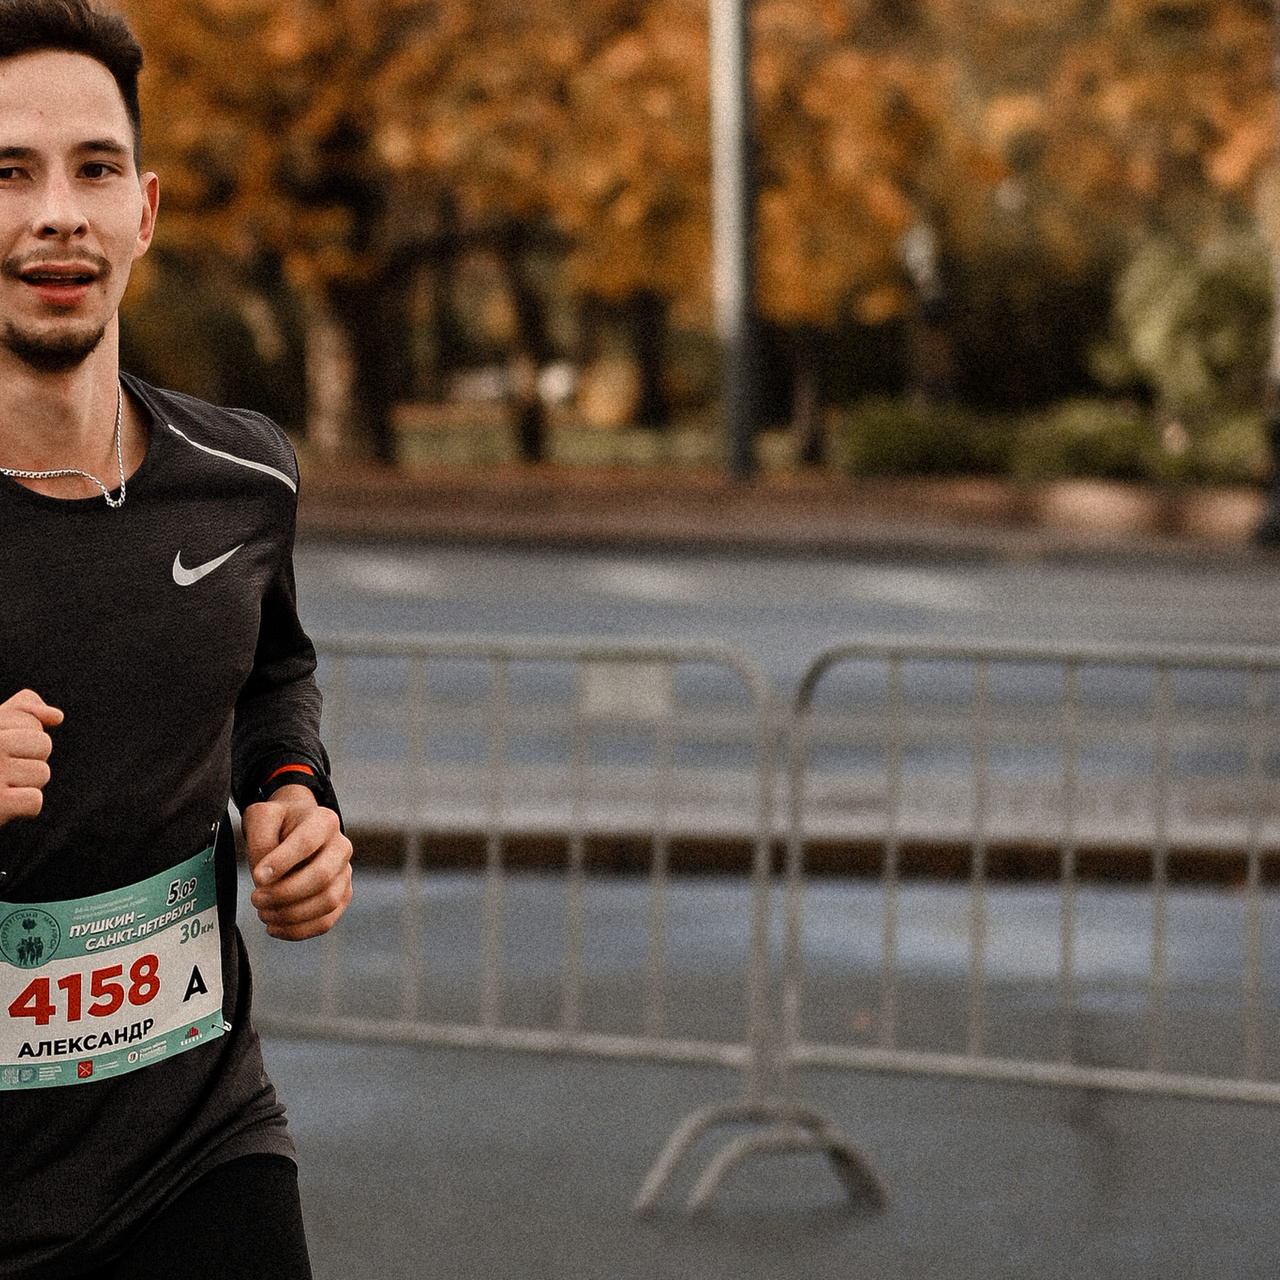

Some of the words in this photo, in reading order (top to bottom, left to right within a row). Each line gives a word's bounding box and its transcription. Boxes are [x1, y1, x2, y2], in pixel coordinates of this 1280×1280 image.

[166, 877, 197, 906] 5.09
[69, 911, 135, 939] ПУШКИН
[85, 898, 198, 951] САНКТ-ПЕТЕРБУРГ
[8, 954, 161, 1025] 4158
[18, 1018, 154, 1058] АЛЕКСАНДР
